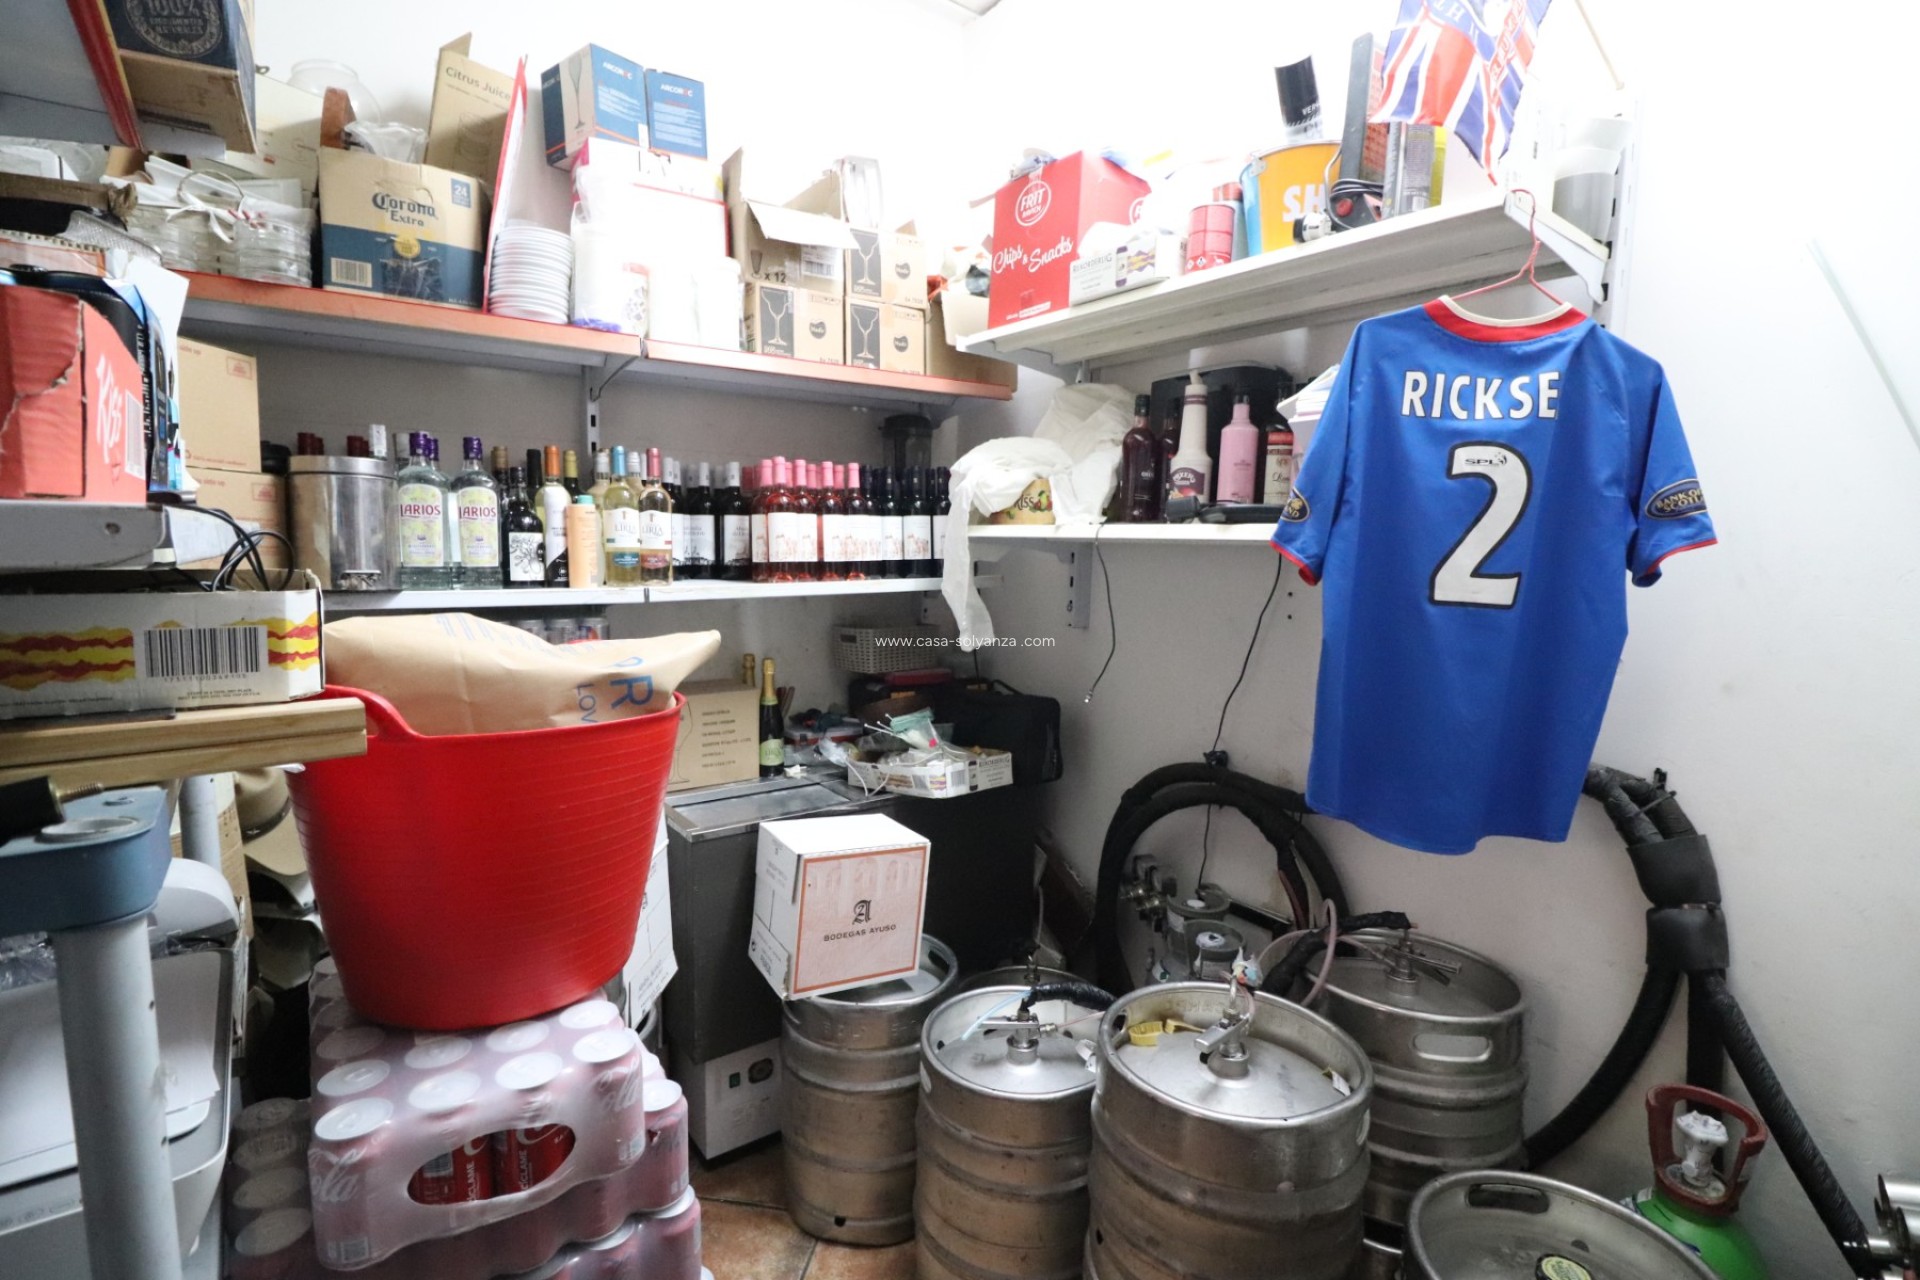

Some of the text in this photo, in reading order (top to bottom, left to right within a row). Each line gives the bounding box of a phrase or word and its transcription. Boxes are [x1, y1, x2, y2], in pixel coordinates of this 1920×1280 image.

[445, 66, 480, 88] Citrus
[454, 183, 468, 197] 24
[1020, 187, 1046, 212] FRIT
[371, 191, 439, 220] Corona
[390, 209, 425, 227] Extra
[992, 244, 1023, 274] Chips
[1027, 233, 1074, 273] Snacks
[775, 272, 787, 283] 12
[1401, 370, 1561, 420] RICKSE
[400, 504, 441, 518] LARIOS
[458, 506, 497, 520] LARIOS
[1429, 440, 1533, 609] 2
[823, 923, 896, 942] BODEGAS AYUSO
